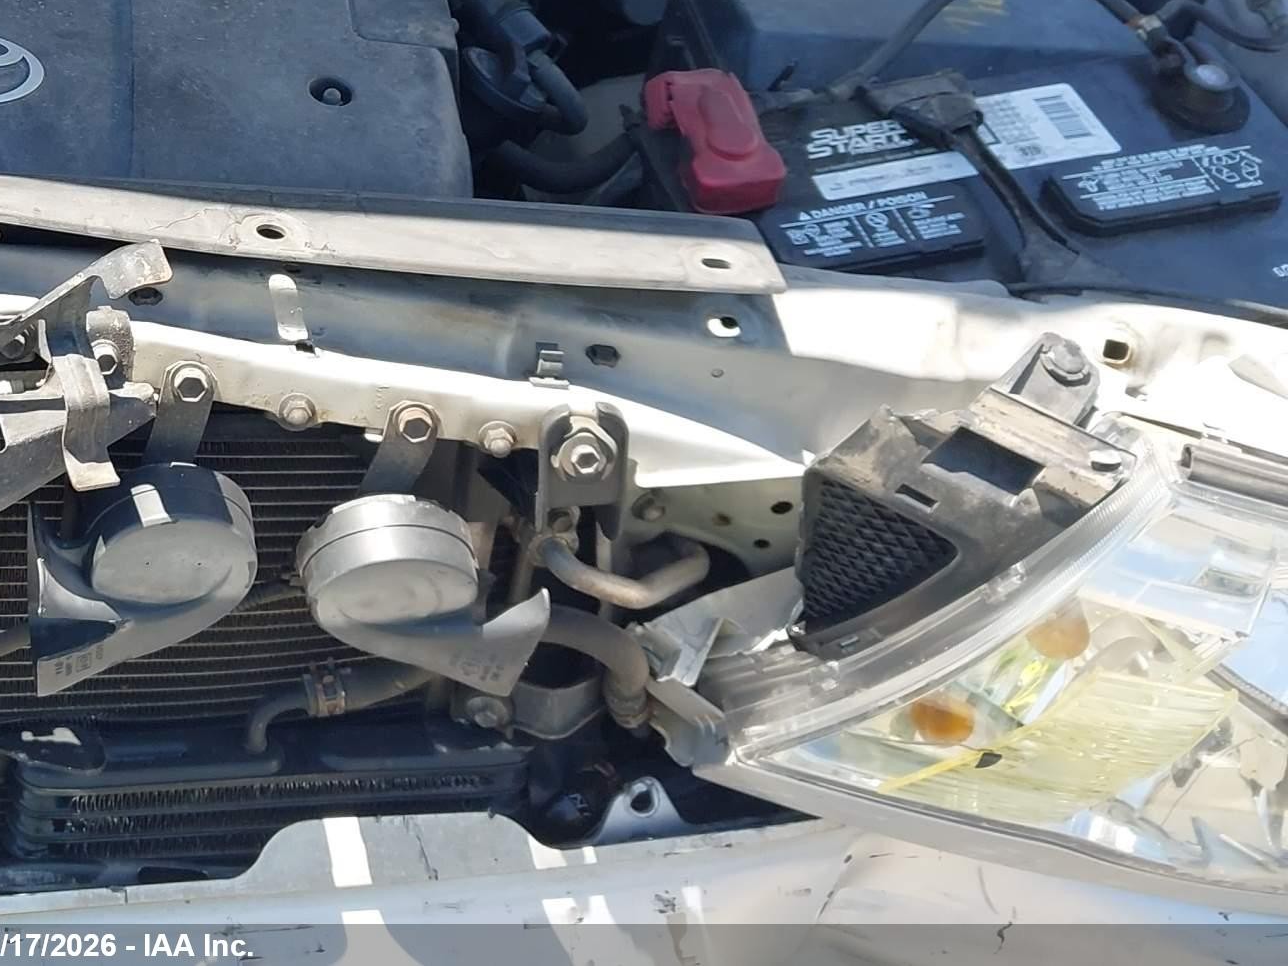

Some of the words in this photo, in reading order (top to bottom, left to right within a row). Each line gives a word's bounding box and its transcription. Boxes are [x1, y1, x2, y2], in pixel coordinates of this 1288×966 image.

[810, 119, 902, 143] SUPER
[806, 131, 907, 160] START
[810, 202, 867, 219] DANGER
[876, 191, 929, 207] POISON
